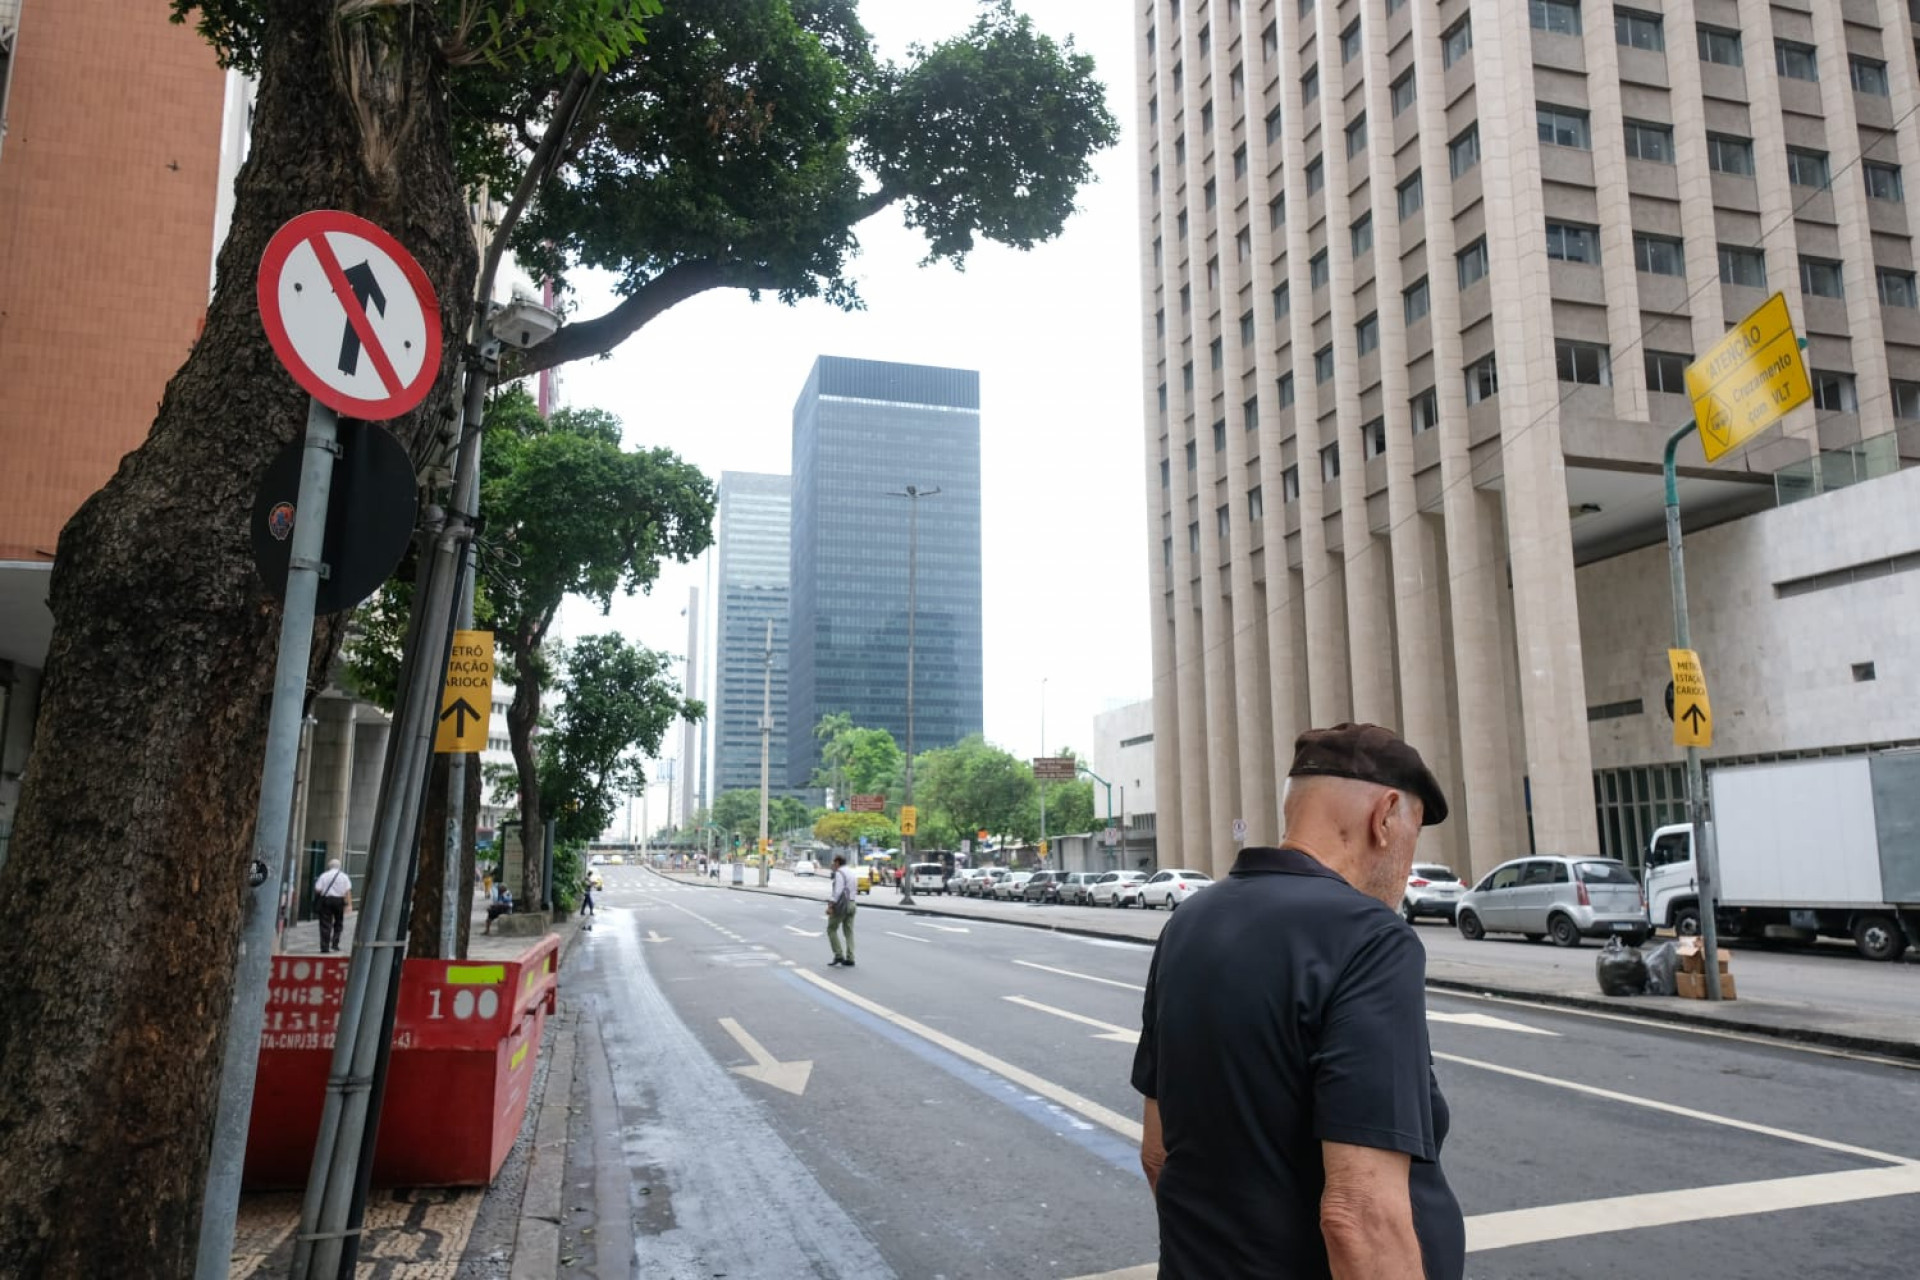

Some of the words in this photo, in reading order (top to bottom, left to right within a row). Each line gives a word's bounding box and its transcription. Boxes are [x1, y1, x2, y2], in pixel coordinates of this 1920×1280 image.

[1732, 353, 1792, 402] Cruzamento
[1772, 382, 1792, 405] VLT
[452, 645, 483, 657] ETRÔ
[449, 660, 489, 674] TAÇÃO
[446, 677, 488, 687] RIOCA
[426, 989, 498, 1020] 100
